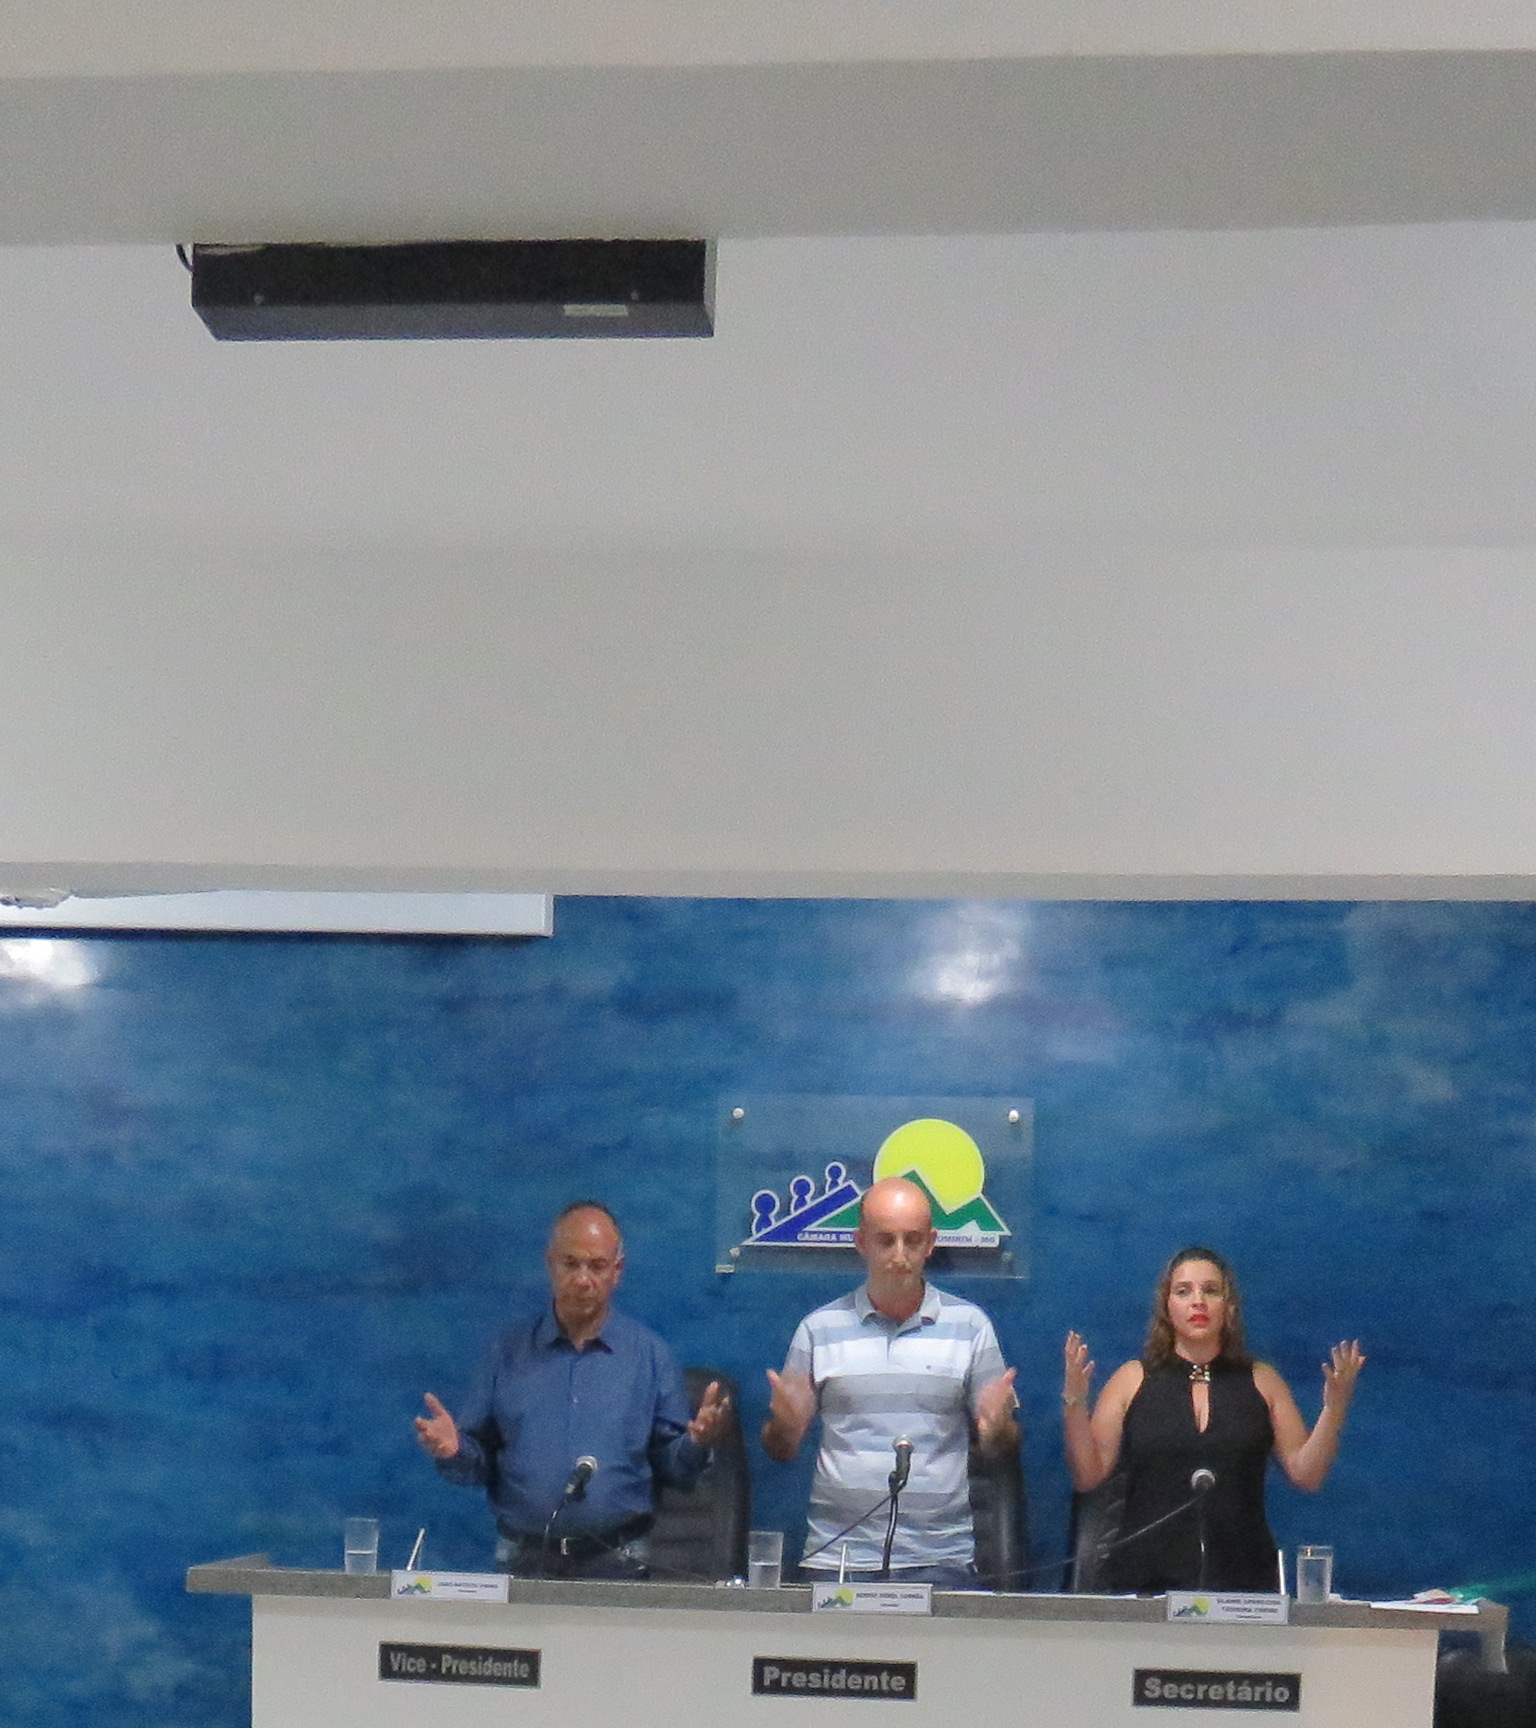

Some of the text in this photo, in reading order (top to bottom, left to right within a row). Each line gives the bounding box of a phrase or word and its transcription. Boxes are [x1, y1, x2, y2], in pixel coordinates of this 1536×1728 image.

[390, 1651, 427, 1673] Vice
[441, 1653, 531, 1679] Presidente
[763, 1665, 907, 1692] Presidente
[1144, 1676, 1290, 1703] Secretário
